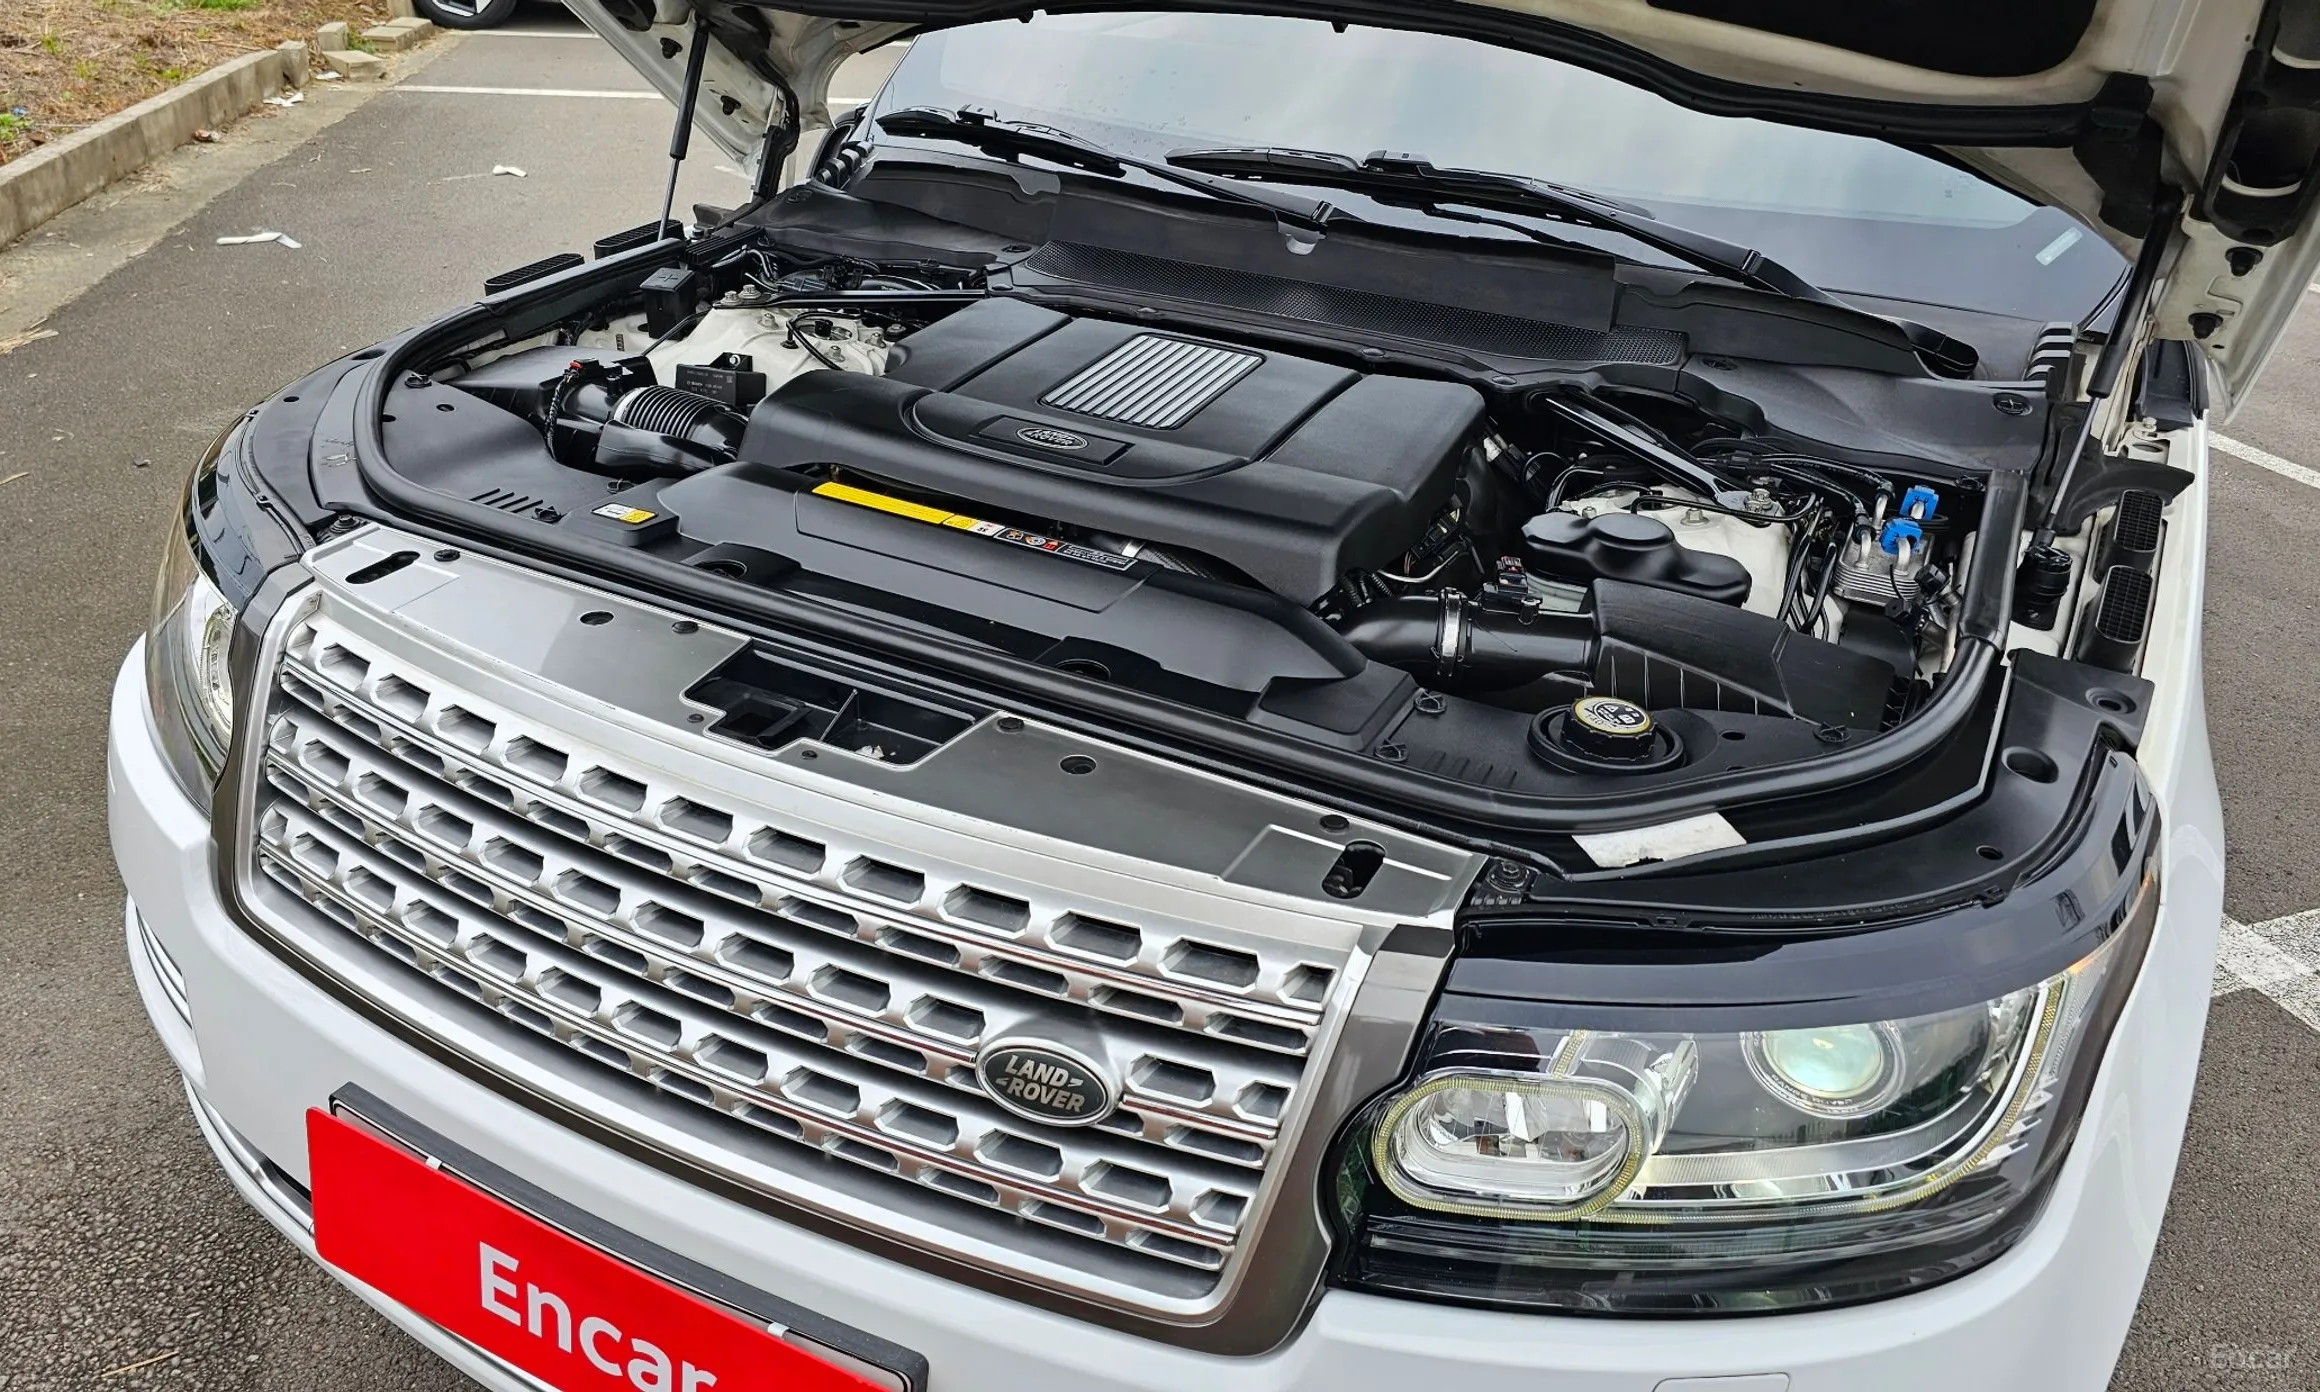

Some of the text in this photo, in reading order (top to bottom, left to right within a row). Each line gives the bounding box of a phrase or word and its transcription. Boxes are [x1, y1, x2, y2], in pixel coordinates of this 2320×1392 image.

[1004, 1054, 1069, 1087] LAND
[1007, 1076, 1085, 1113] ROVER
[478, 1240, 718, 1392] Encar
